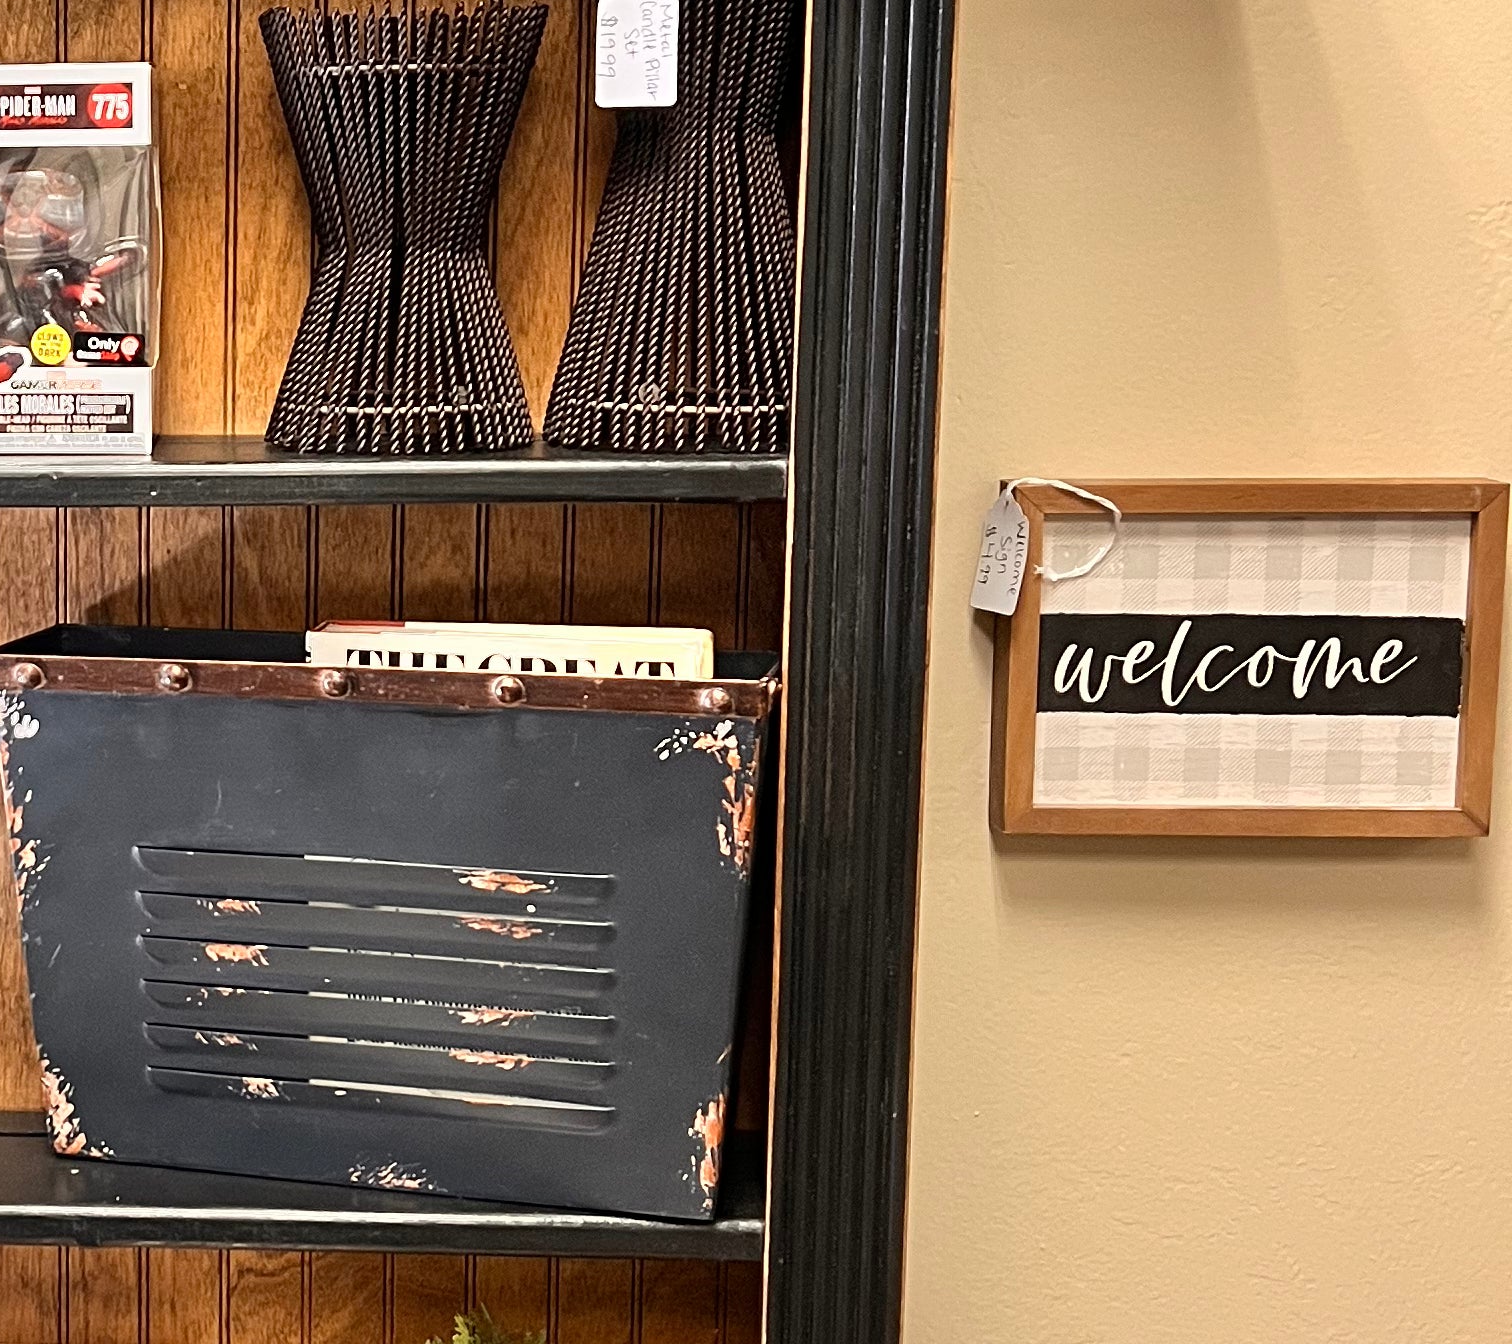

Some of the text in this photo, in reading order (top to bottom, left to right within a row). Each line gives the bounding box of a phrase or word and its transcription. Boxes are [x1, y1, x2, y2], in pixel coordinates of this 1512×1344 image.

[91, 93, 131, 121] 775
[88, 337, 121, 353] Only
[1054, 620, 1418, 706] welcome
